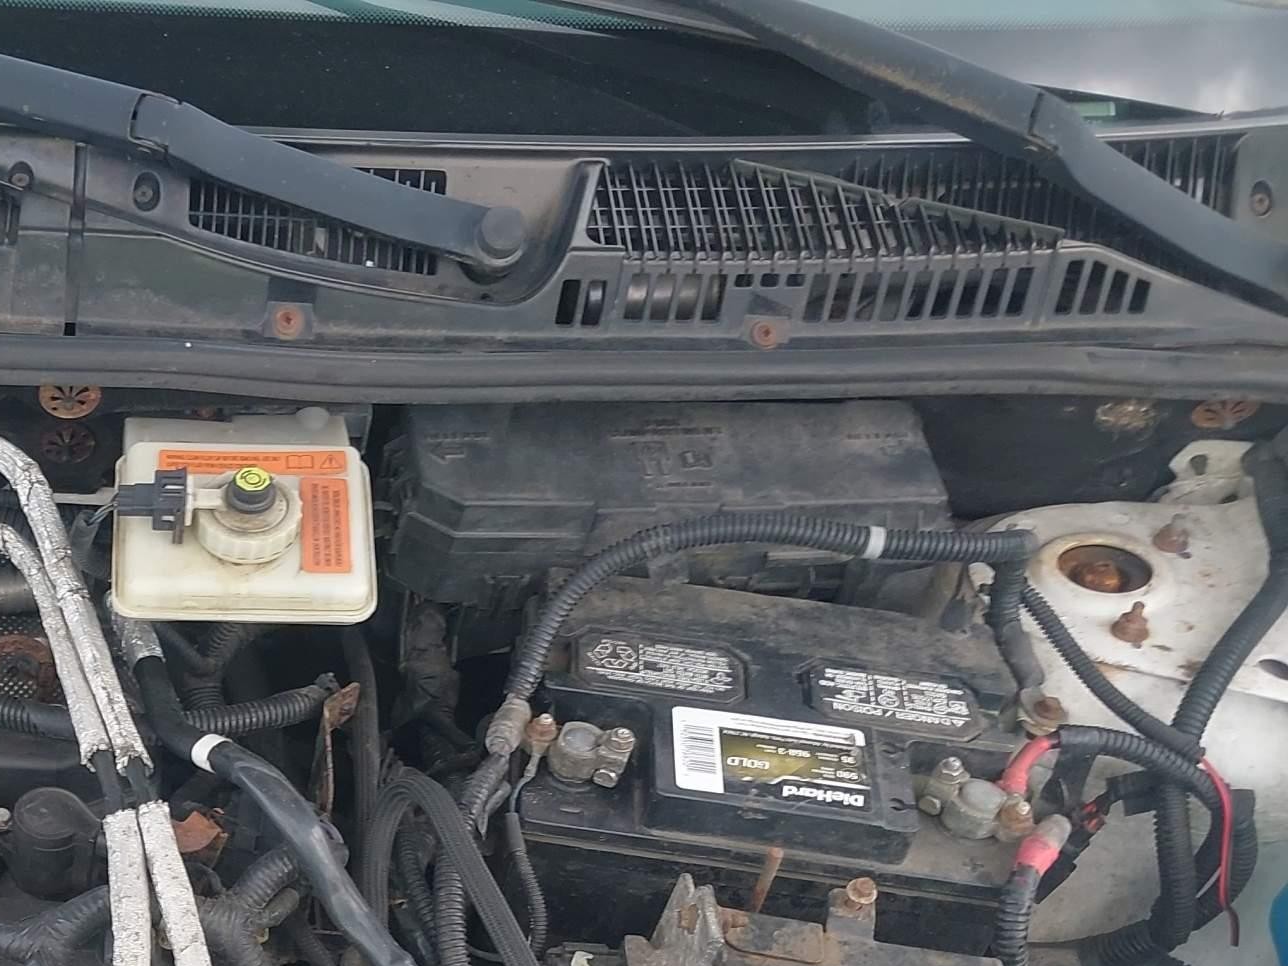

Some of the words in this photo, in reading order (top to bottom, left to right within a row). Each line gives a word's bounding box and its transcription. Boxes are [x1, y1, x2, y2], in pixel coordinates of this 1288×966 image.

[833, 702, 883, 716] POISON
[895, 712, 952, 726] DANGER
[726, 756, 770, 770] GOLD
[782, 785, 865, 807] DieHard
